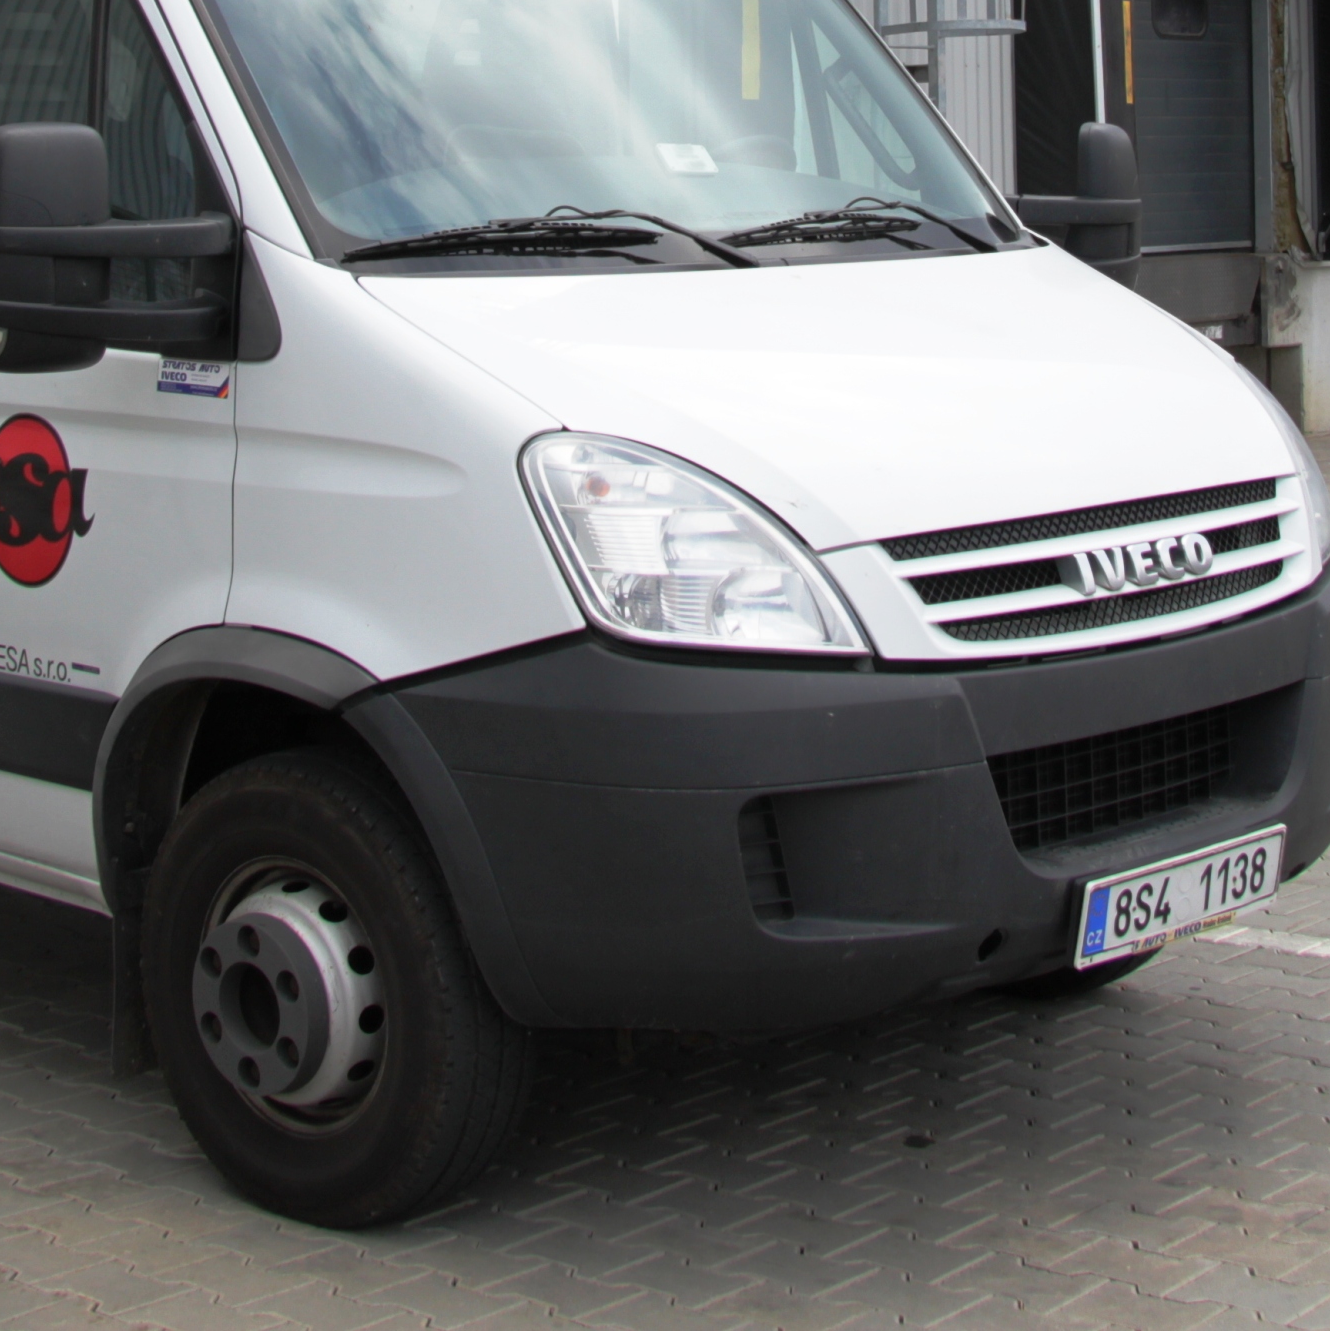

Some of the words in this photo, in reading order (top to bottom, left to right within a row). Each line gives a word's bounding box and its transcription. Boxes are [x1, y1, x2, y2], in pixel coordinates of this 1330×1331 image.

[161, 370, 187, 382] IVECO
[199, 363, 221, 374] AUTO
[1072, 532, 1214, 597] IVECO
[33, 657, 71, 683] s.r.o.
[1113, 876, 1171, 938] 8S4
[1200, 846, 1267, 911] 1138
[1086, 928, 1103, 946] CZ
[1174, 921, 1202, 939] IVECO
